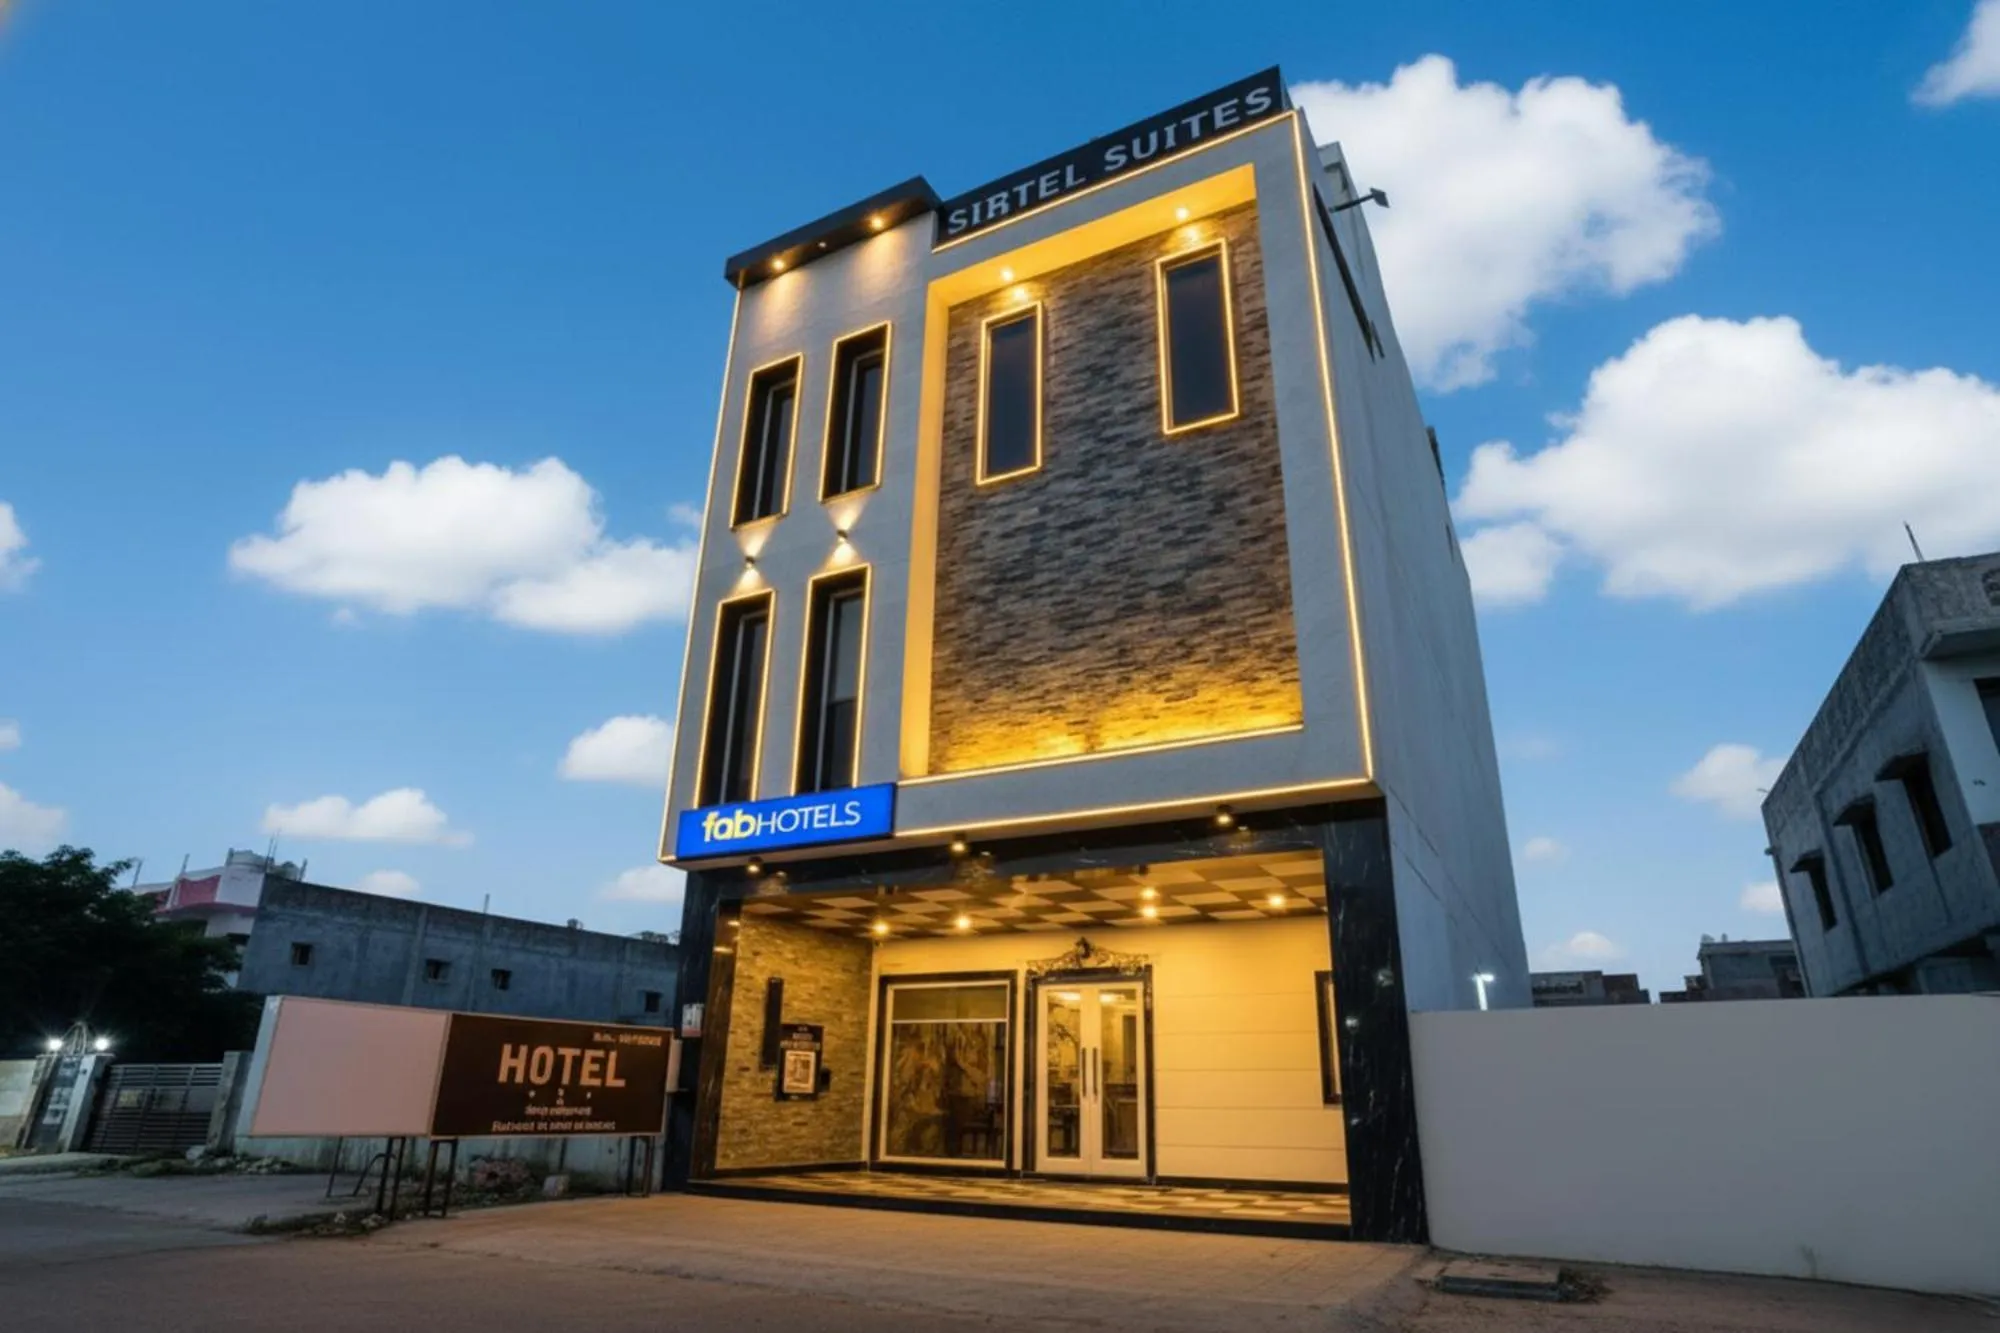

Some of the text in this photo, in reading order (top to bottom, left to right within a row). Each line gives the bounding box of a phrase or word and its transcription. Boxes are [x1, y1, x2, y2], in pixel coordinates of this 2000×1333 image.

[947, 86, 1272, 236] SIRTEL SUITES
[497, 1043, 626, 1088] HOTEL
